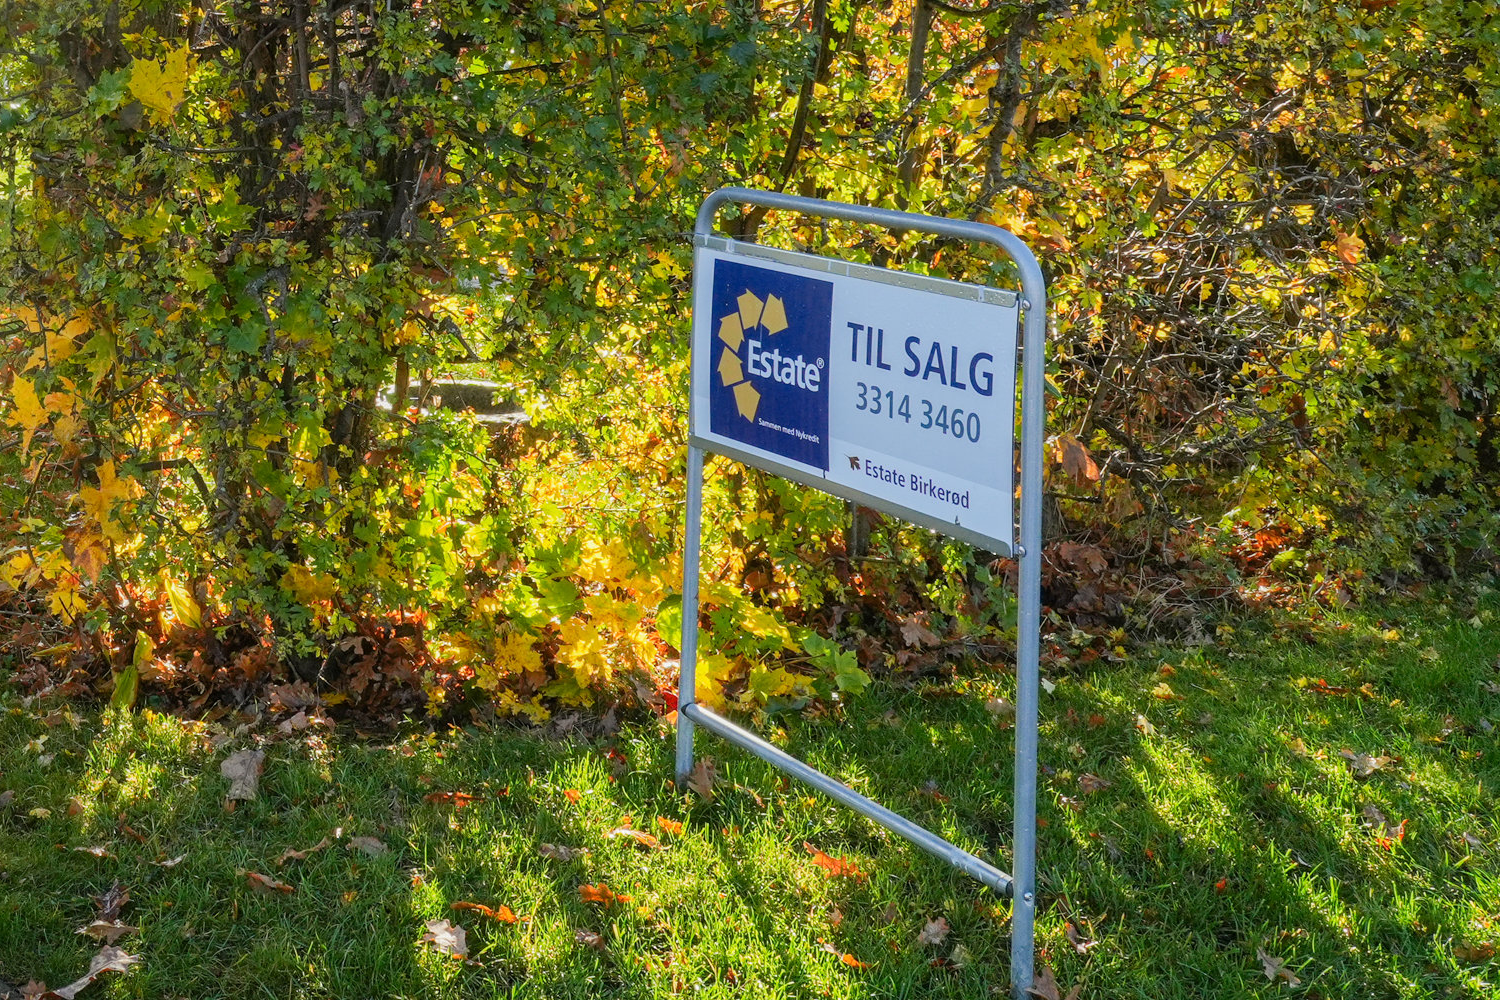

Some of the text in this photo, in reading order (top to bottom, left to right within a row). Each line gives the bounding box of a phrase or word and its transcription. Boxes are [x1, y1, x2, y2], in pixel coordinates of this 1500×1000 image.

[847, 321, 994, 397] TIL SALG
[758, 417, 820, 444] Sammen med Nykredit
[856, 381, 981, 443] 3314 3460
[865, 459, 970, 510] Estate Birkerød
